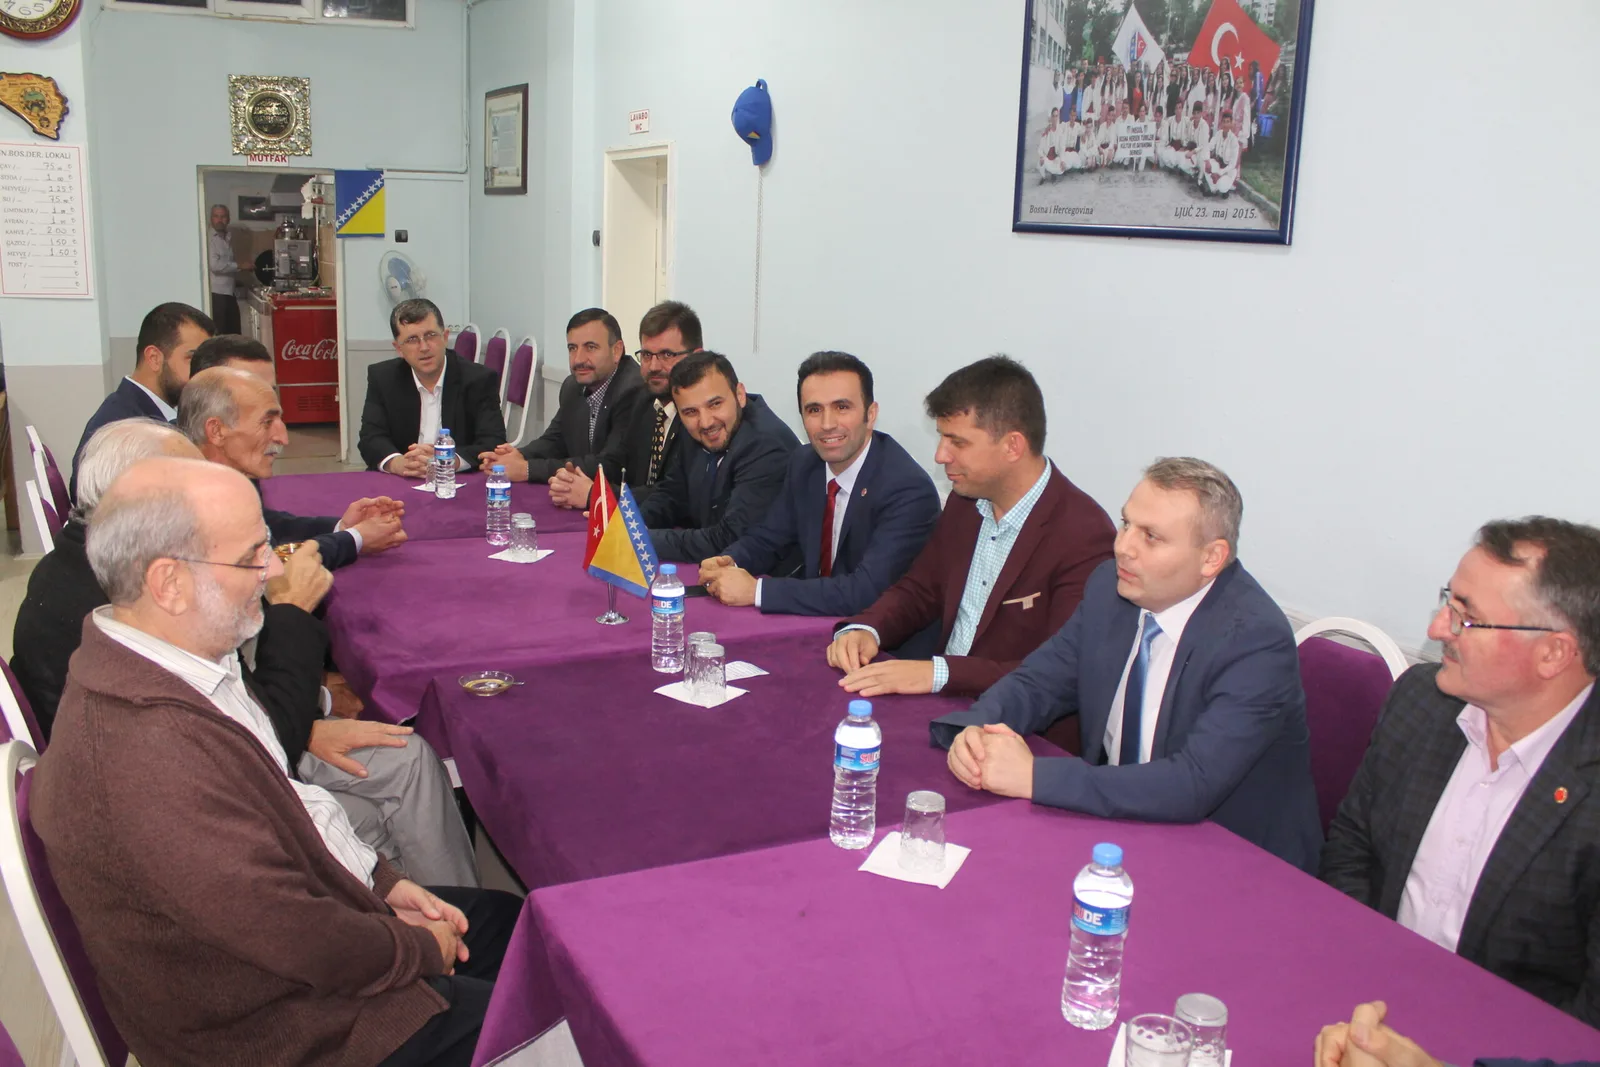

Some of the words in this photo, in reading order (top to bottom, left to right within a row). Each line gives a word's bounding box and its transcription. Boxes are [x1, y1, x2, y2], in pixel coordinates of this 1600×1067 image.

[249, 153, 287, 162] MUTFAK
[1029, 204, 1048, 214] Bosna
[1053, 205, 1094, 216] Hercegovina
[1195, 207, 1208, 218] 23.
[1212, 208, 1228, 220] maj
[1232, 208, 1257, 219] 2015.
[860, 751, 880, 763] SUD
